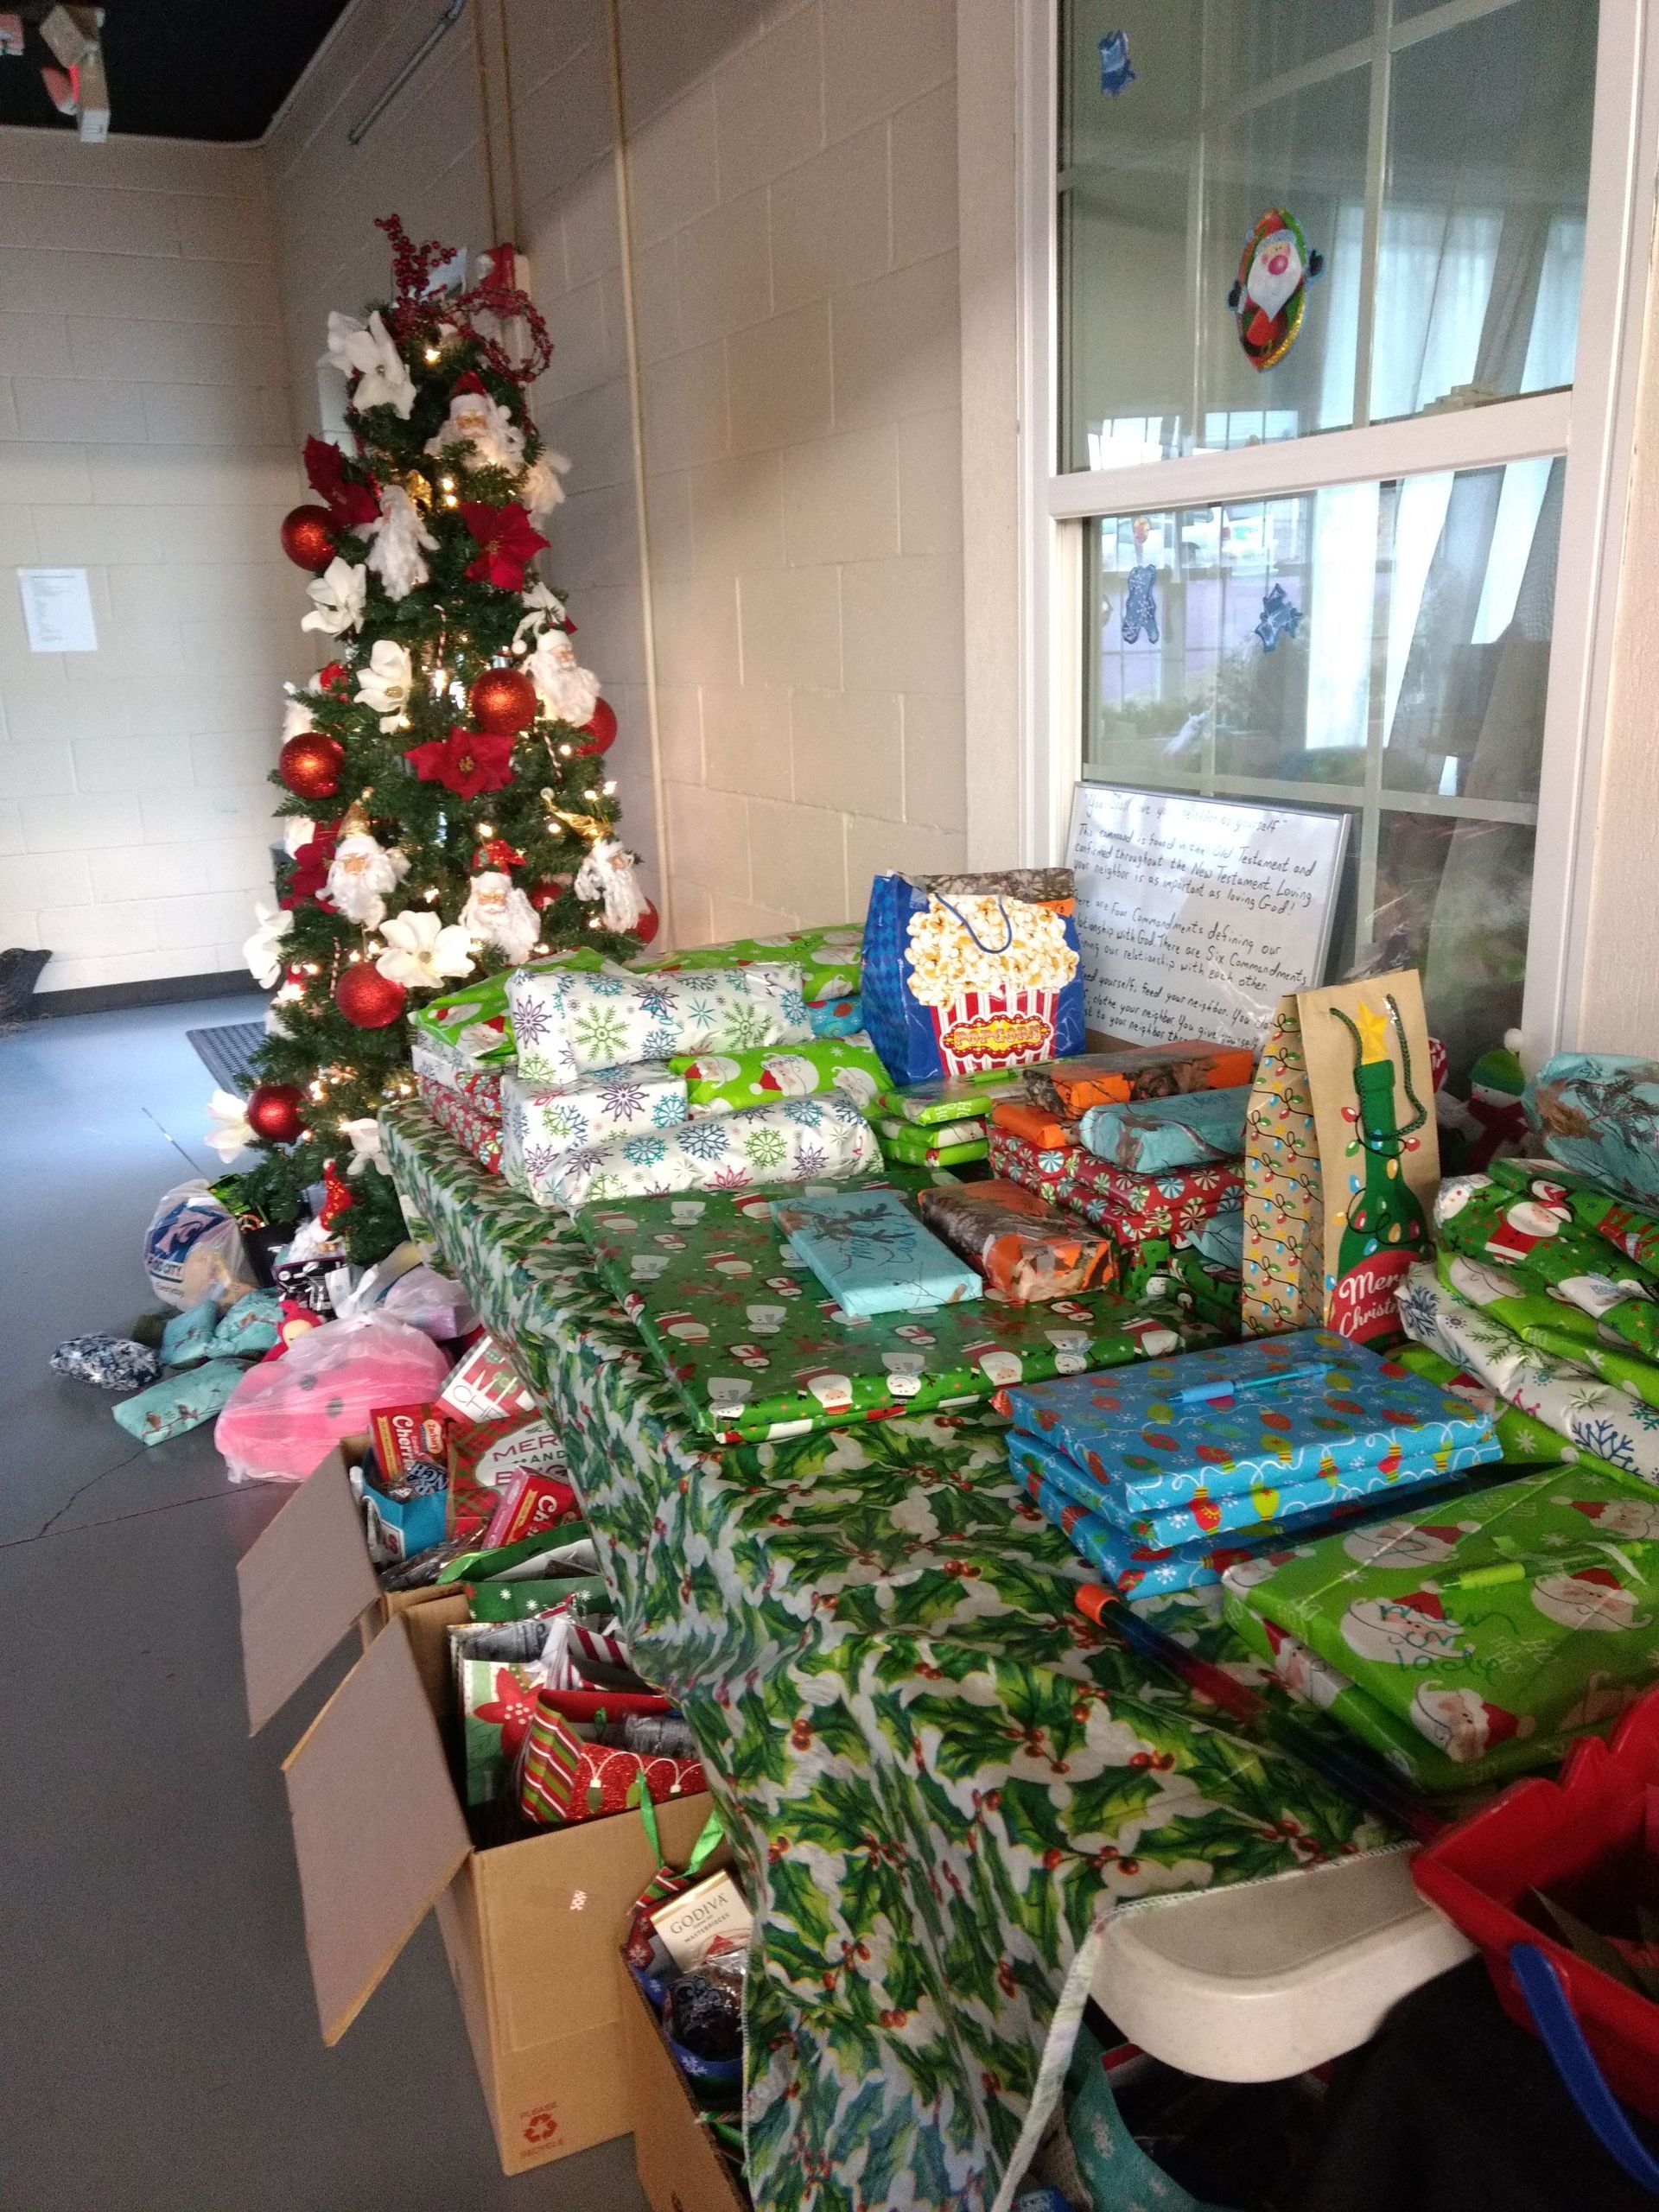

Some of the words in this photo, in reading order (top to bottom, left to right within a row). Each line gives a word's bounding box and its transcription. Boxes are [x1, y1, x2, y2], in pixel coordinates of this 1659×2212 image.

[1116, 850, 1164, 868] throughout
[1170, 858, 1186, 872] the
[1191, 861, 1213, 880] New
[1276, 879, 1313, 908] Loving
[1239, 846, 1290, 873] Testament
[1293, 860, 1317, 877] and
[1094, 863, 1130, 880] neighbor
[1135, 871, 1144, 883] is
[1147, 875, 1159, 887] as
[1162, 880, 1205, 897] important
[1209, 889, 1221, 900] as
[1227, 888, 1255, 911] loving
[1258, 894, 1295, 917] God!
[1132, 906, 1204, 935] Commandments
[1207, 921, 1254, 955] defining
[1262, 944, 1281, 956] our
[1104, 944, 1120, 956] our
[1123, 948, 1175, 971] relationship
[1180, 962, 1205, 976] with
[1208, 969, 1234, 982] each
[1158, 932, 1180, 956] There
[1185, 946, 1200, 958] are
[1205, 944, 1225, 965] Six
[1230, 951, 1306, 986] Commandments
[1120, 1004, 1141, 1015] your
[1178, 1014, 1194, 1033] You
[1198, 1026, 1217, 1039] give
[1142, 982, 1164, 998] feed
[1166, 992, 1187, 1004] your
[1231, 1007, 1250, 1027] You
[954, 1025, 1042, 1046] POPCORN
[1128, 1021, 1166, 1039] neighbor
[1339, 1298, 1400, 1338] Christ
[493, 1433, 559, 1462] MER
[530, 1449, 567, 1464] AND
[670, 1892, 728, 1935] GODIVA
